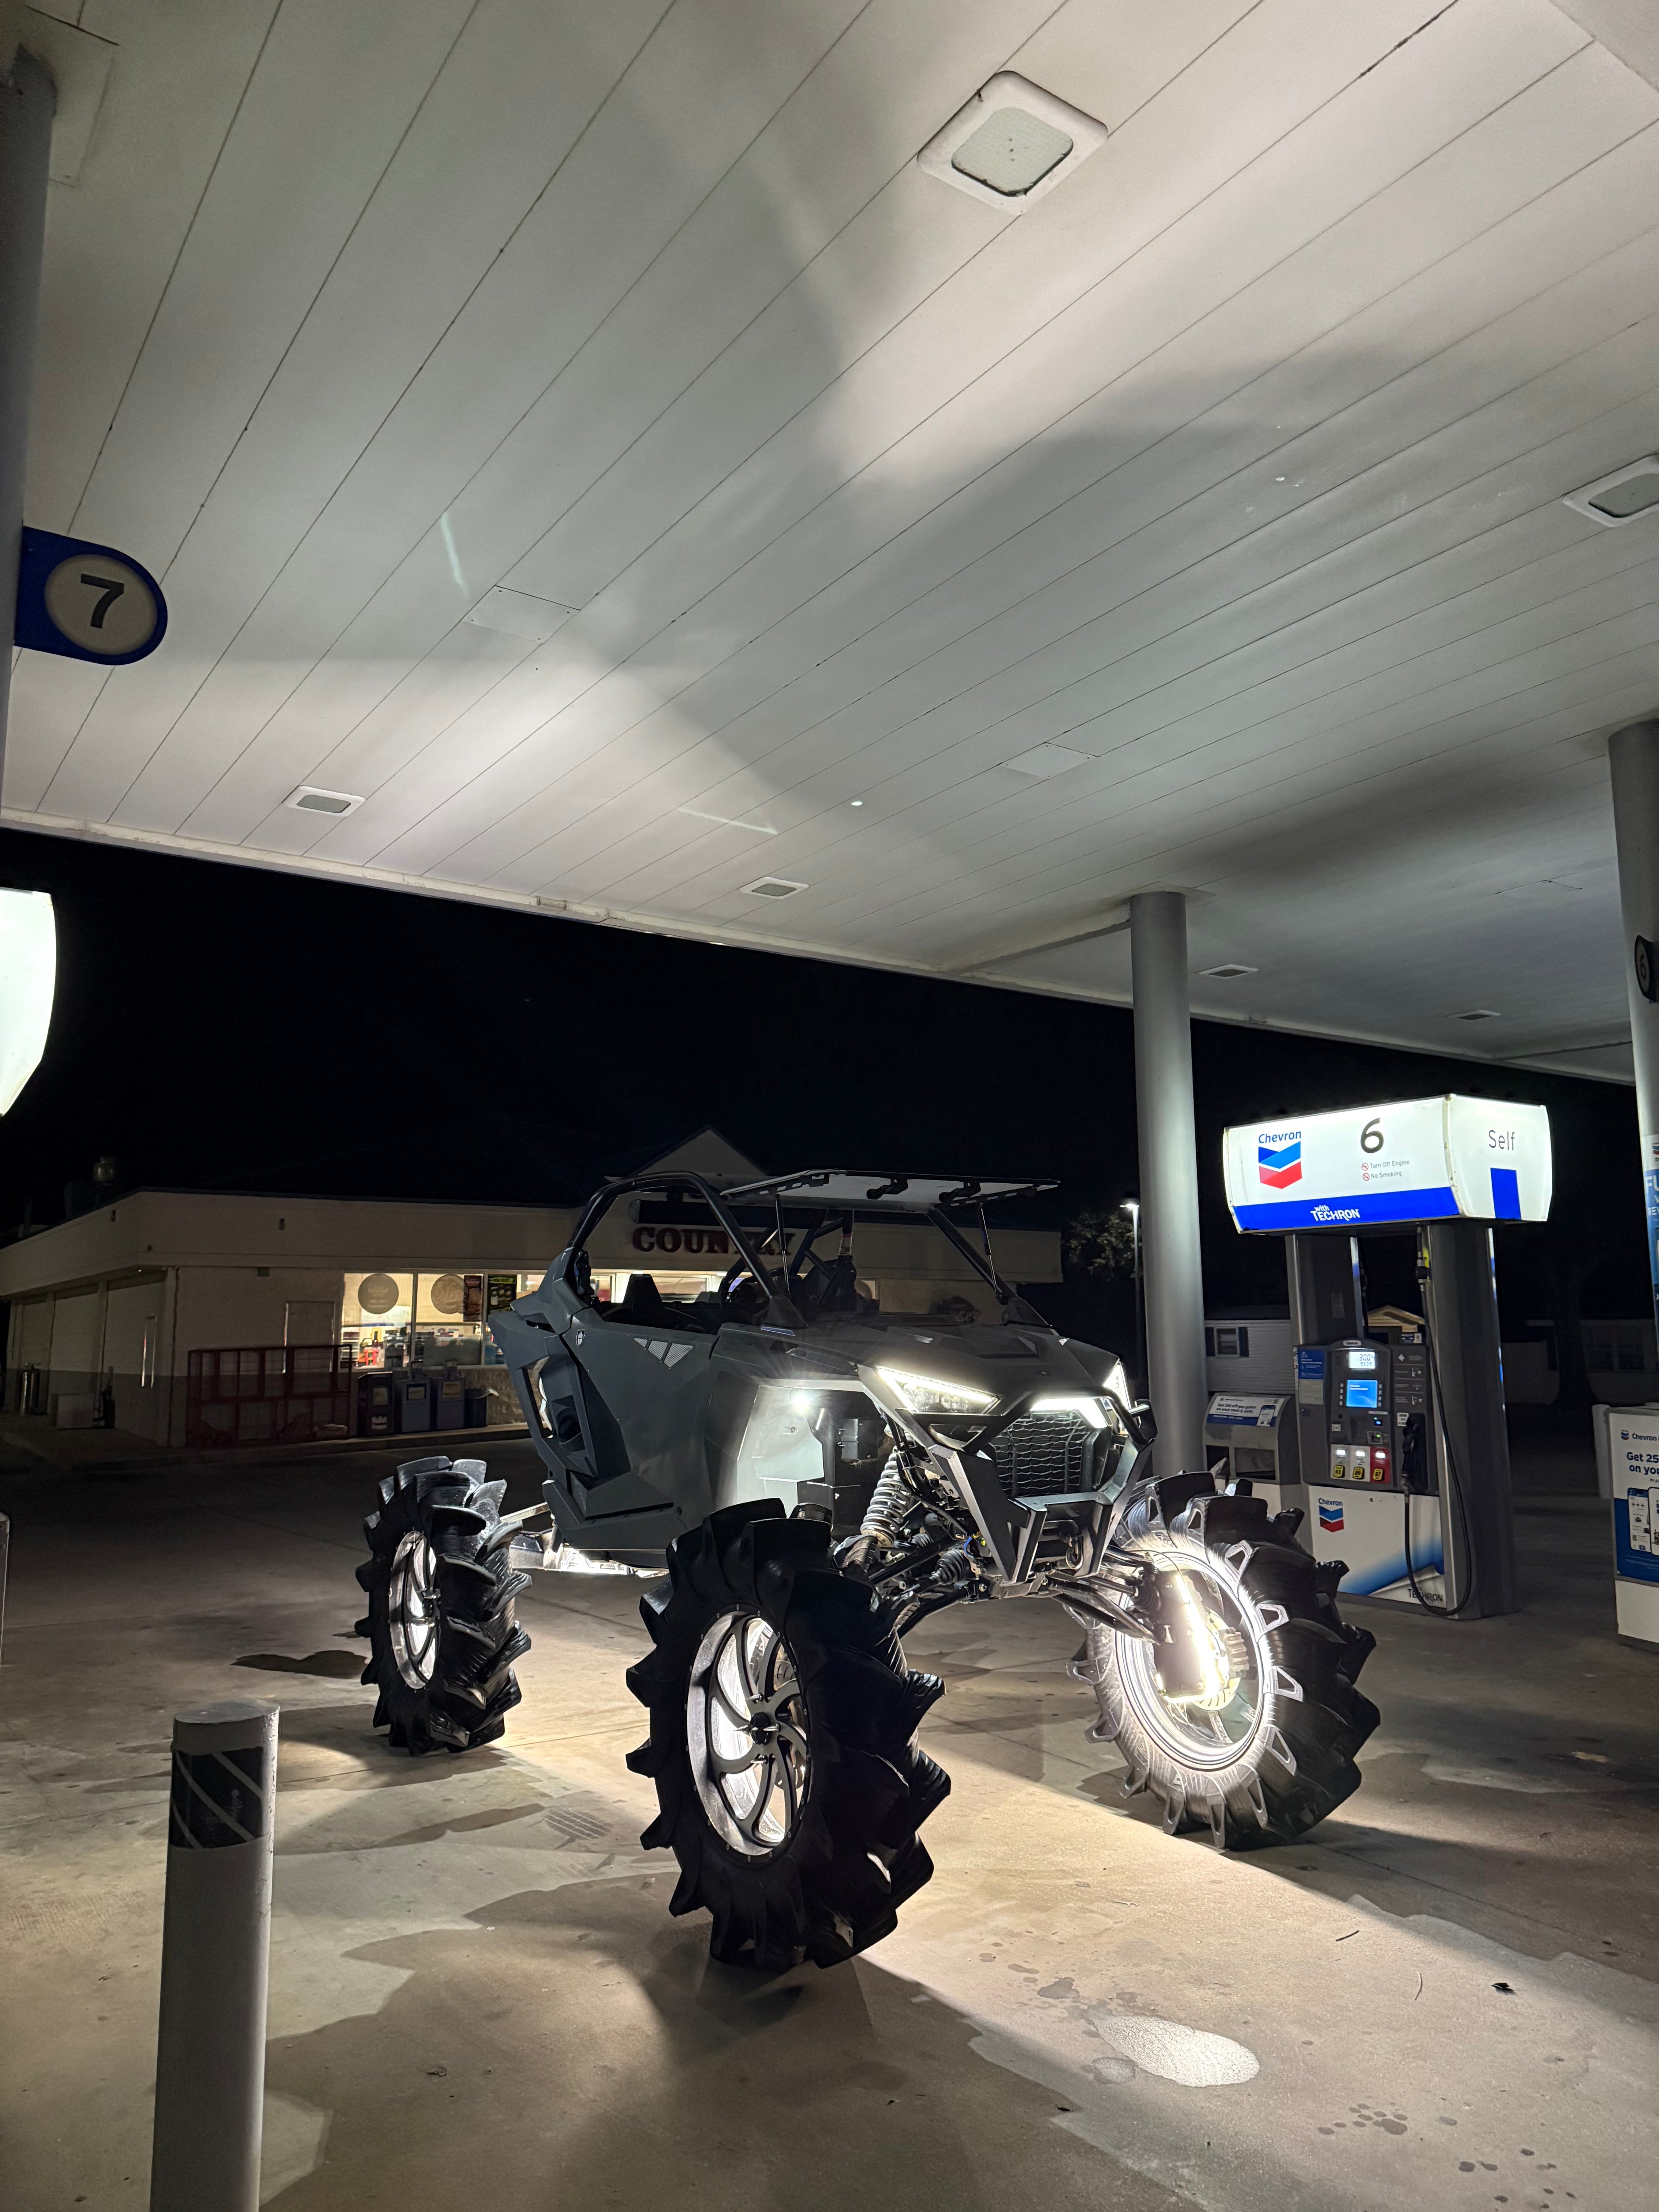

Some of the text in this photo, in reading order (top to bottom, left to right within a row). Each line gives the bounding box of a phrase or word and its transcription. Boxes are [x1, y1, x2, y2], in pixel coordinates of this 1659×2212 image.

[81, 573, 124, 629] 7
[1259, 1131, 1301, 1144] Chevron
[1360, 1117, 1384, 1153] 6
[1489, 1129, 1515, 1150] Self
[1310, 1209, 1360, 1221] TECHRON
[632, 1227, 795, 1255] COUNY
[1627, 1452, 1643, 1462] Get
[1629, 1465, 1641, 1473] on
[1318, 1497, 1343, 1506] Chevron
[1408, 1589, 1444, 1602] TEHRON
